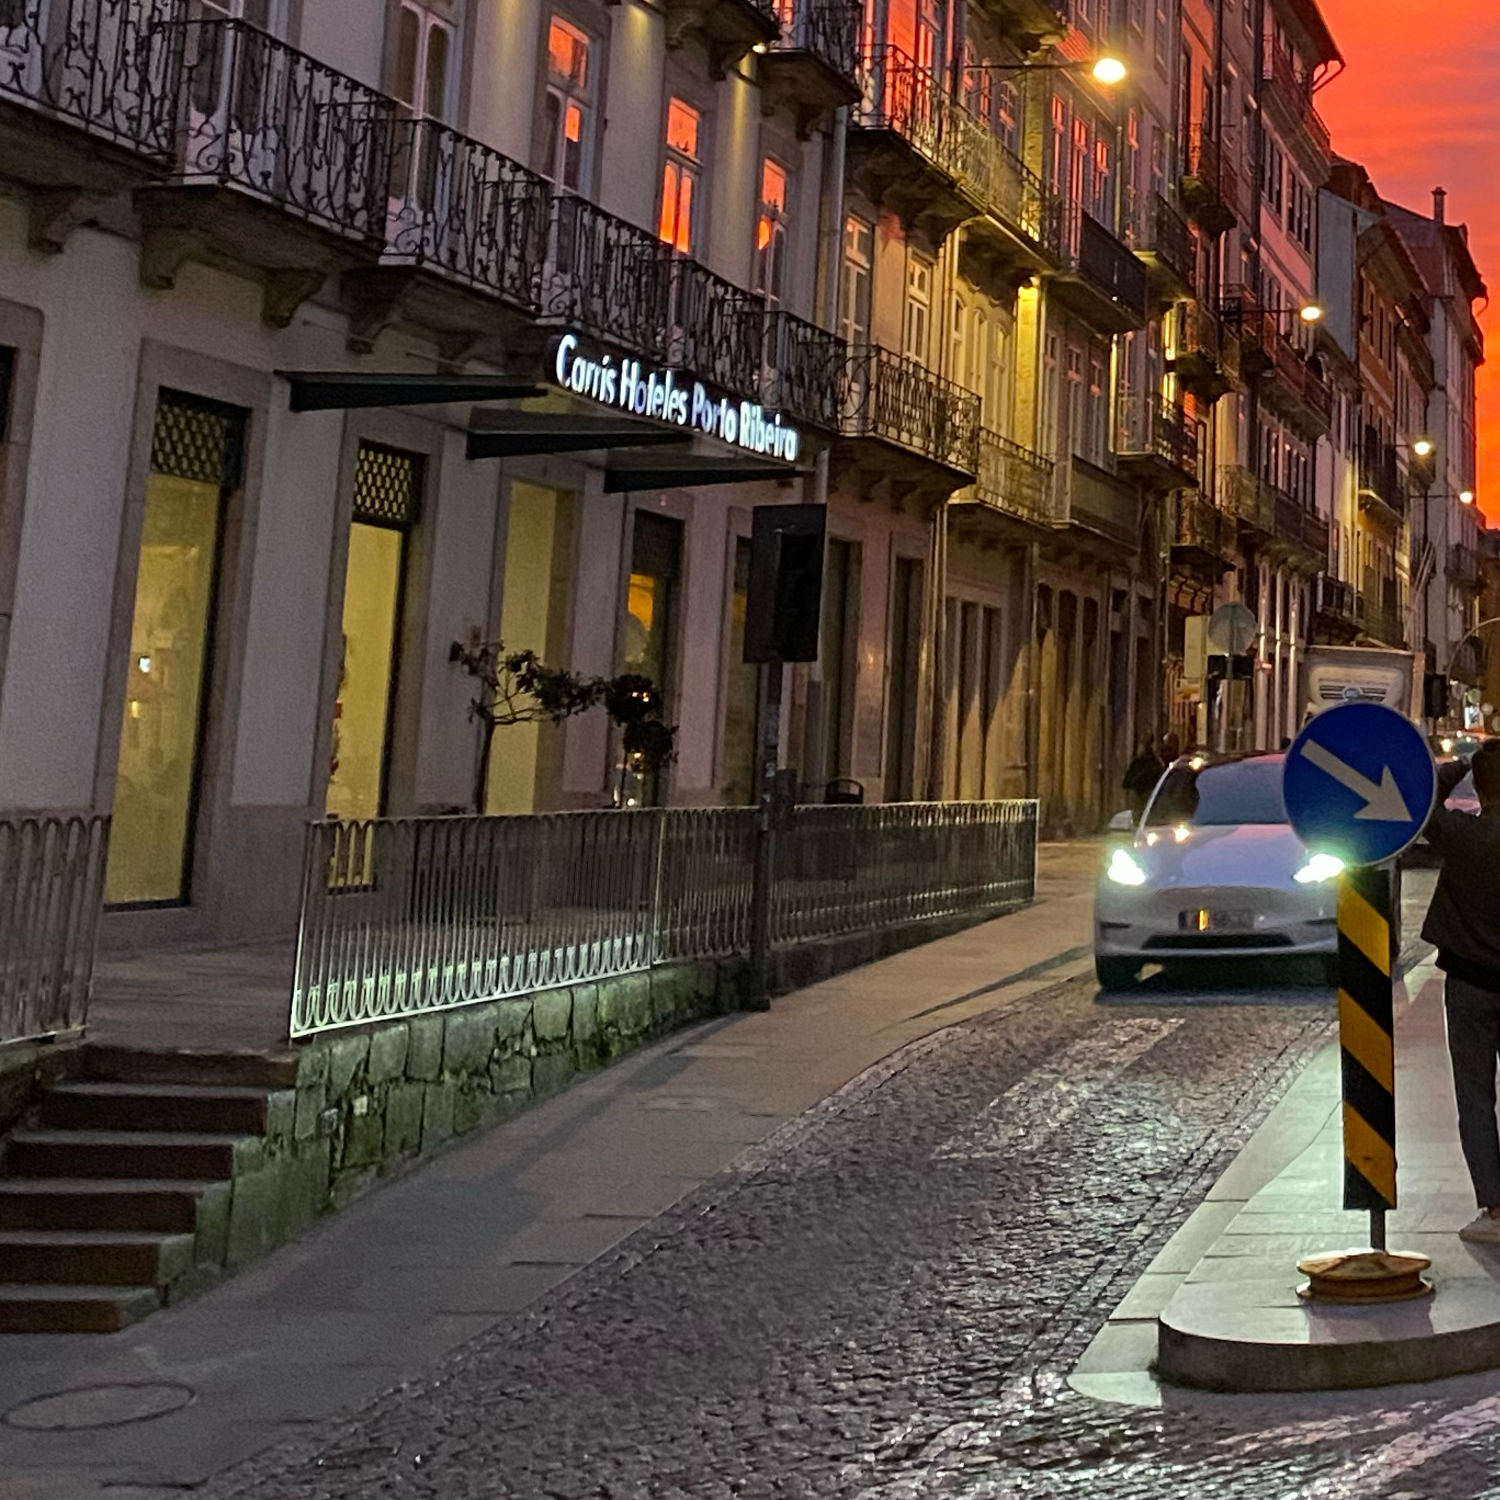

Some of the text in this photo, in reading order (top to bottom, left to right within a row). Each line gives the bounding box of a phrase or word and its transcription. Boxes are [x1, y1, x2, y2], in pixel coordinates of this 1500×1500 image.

[555, 333, 799, 462] Carris Hoteles Porto Ribeira
